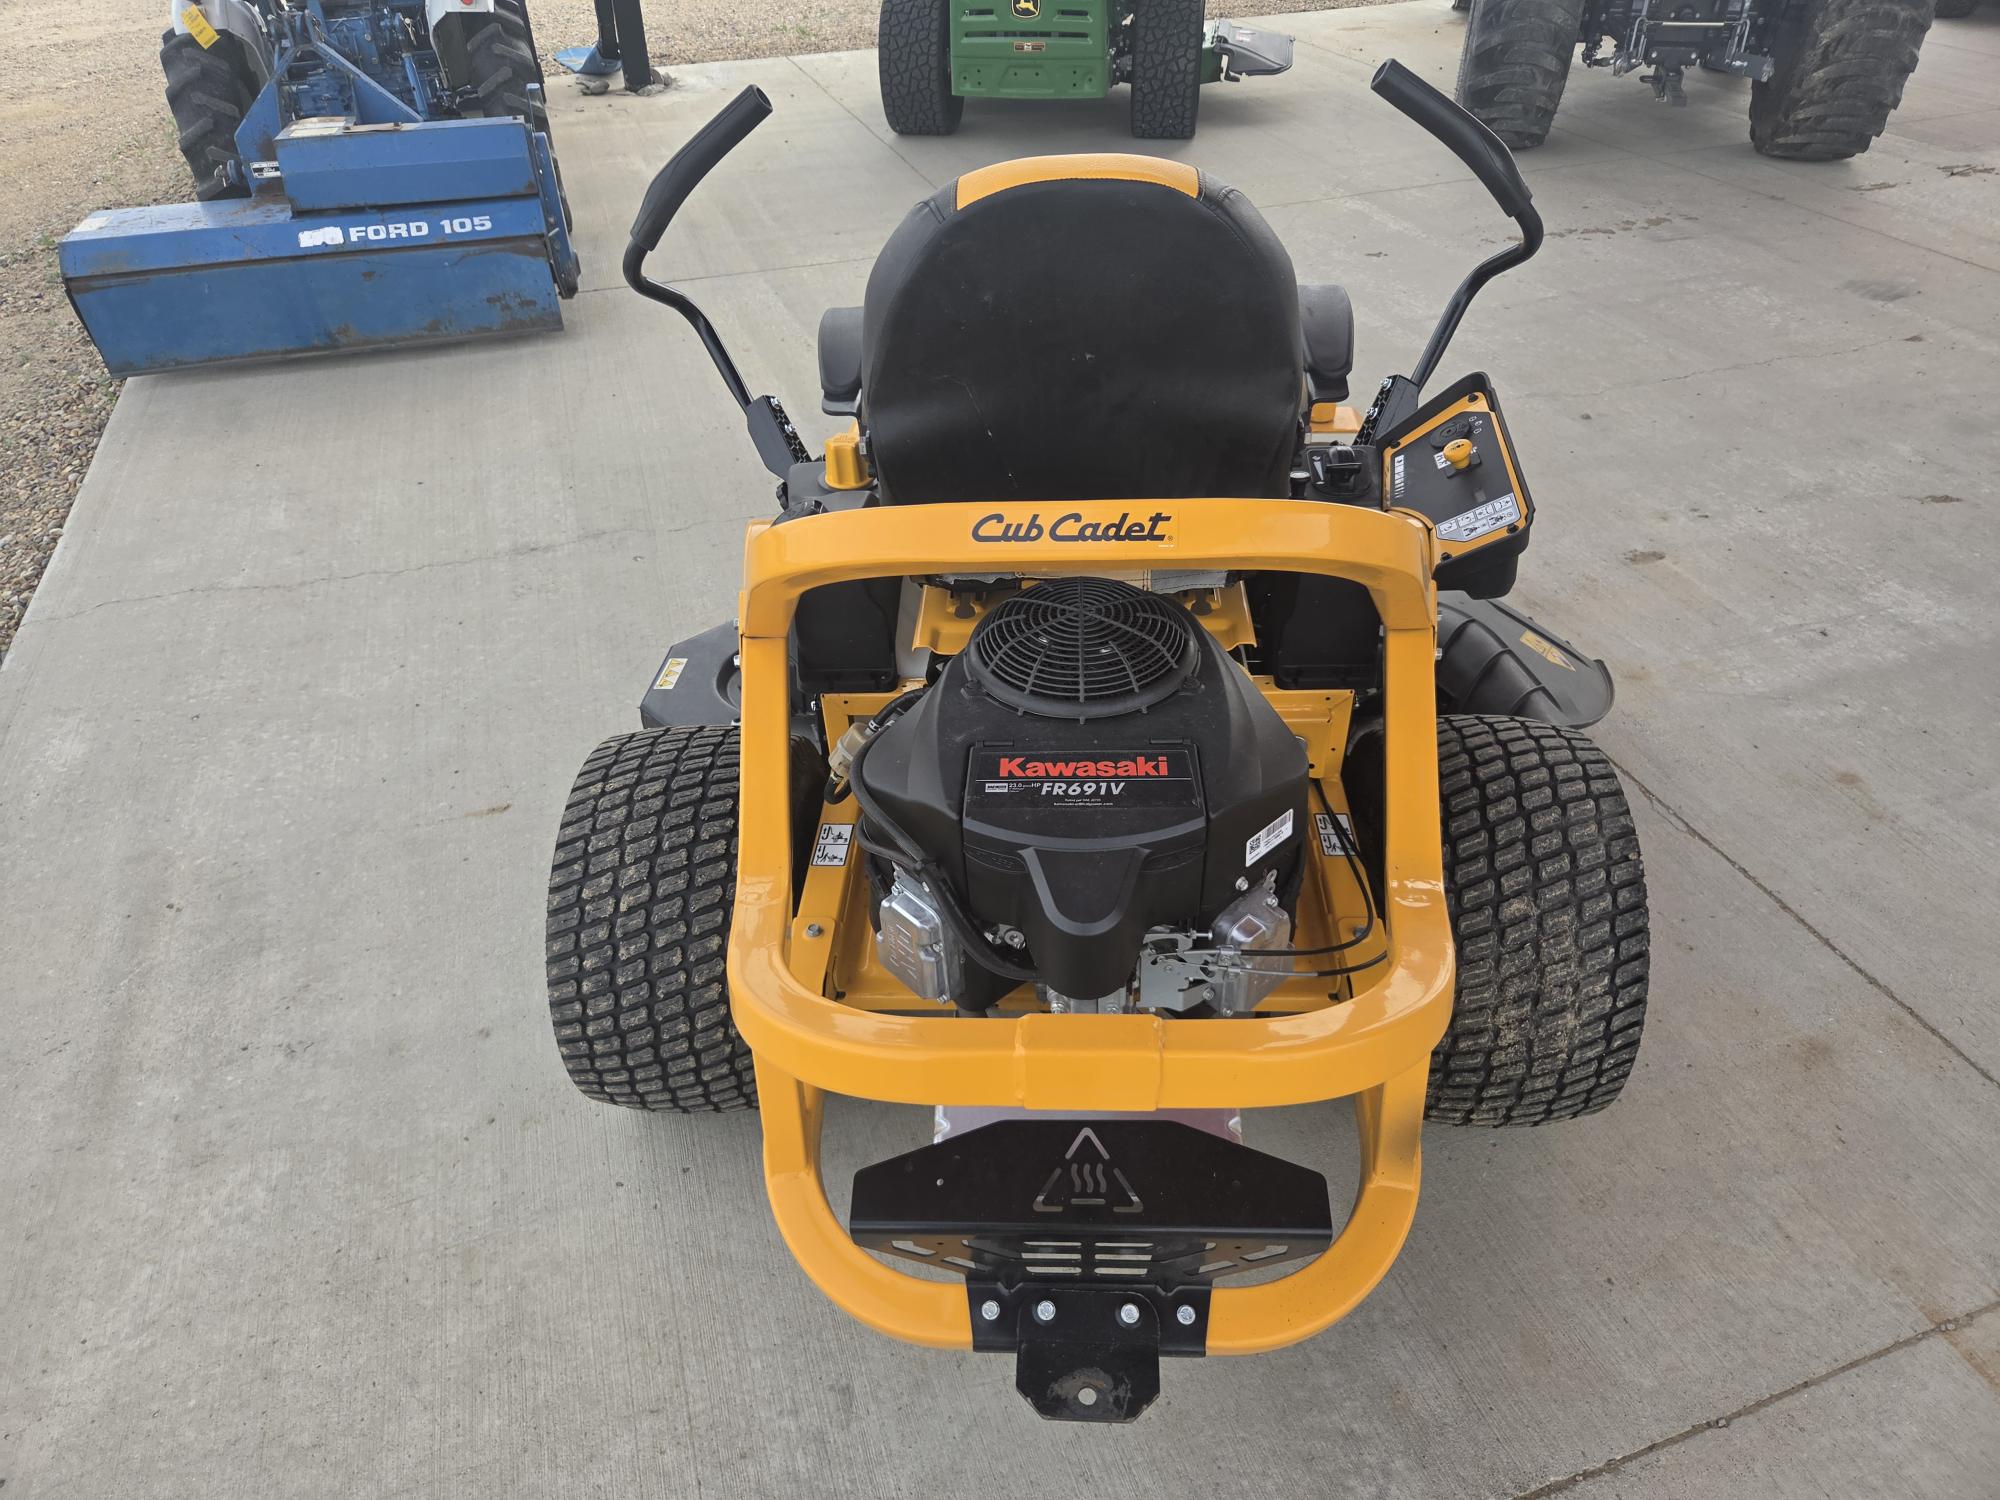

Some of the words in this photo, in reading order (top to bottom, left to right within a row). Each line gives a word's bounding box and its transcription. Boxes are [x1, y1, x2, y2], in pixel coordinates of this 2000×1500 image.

[348, 221, 429, 242] FORD
[439, 215, 492, 234] 105
[971, 513, 1044, 542] Cub
[1048, 512, 1172, 542] Cadet
[999, 756, 1169, 777] Kawasaki
[1040, 782, 1126, 796] FR691V
